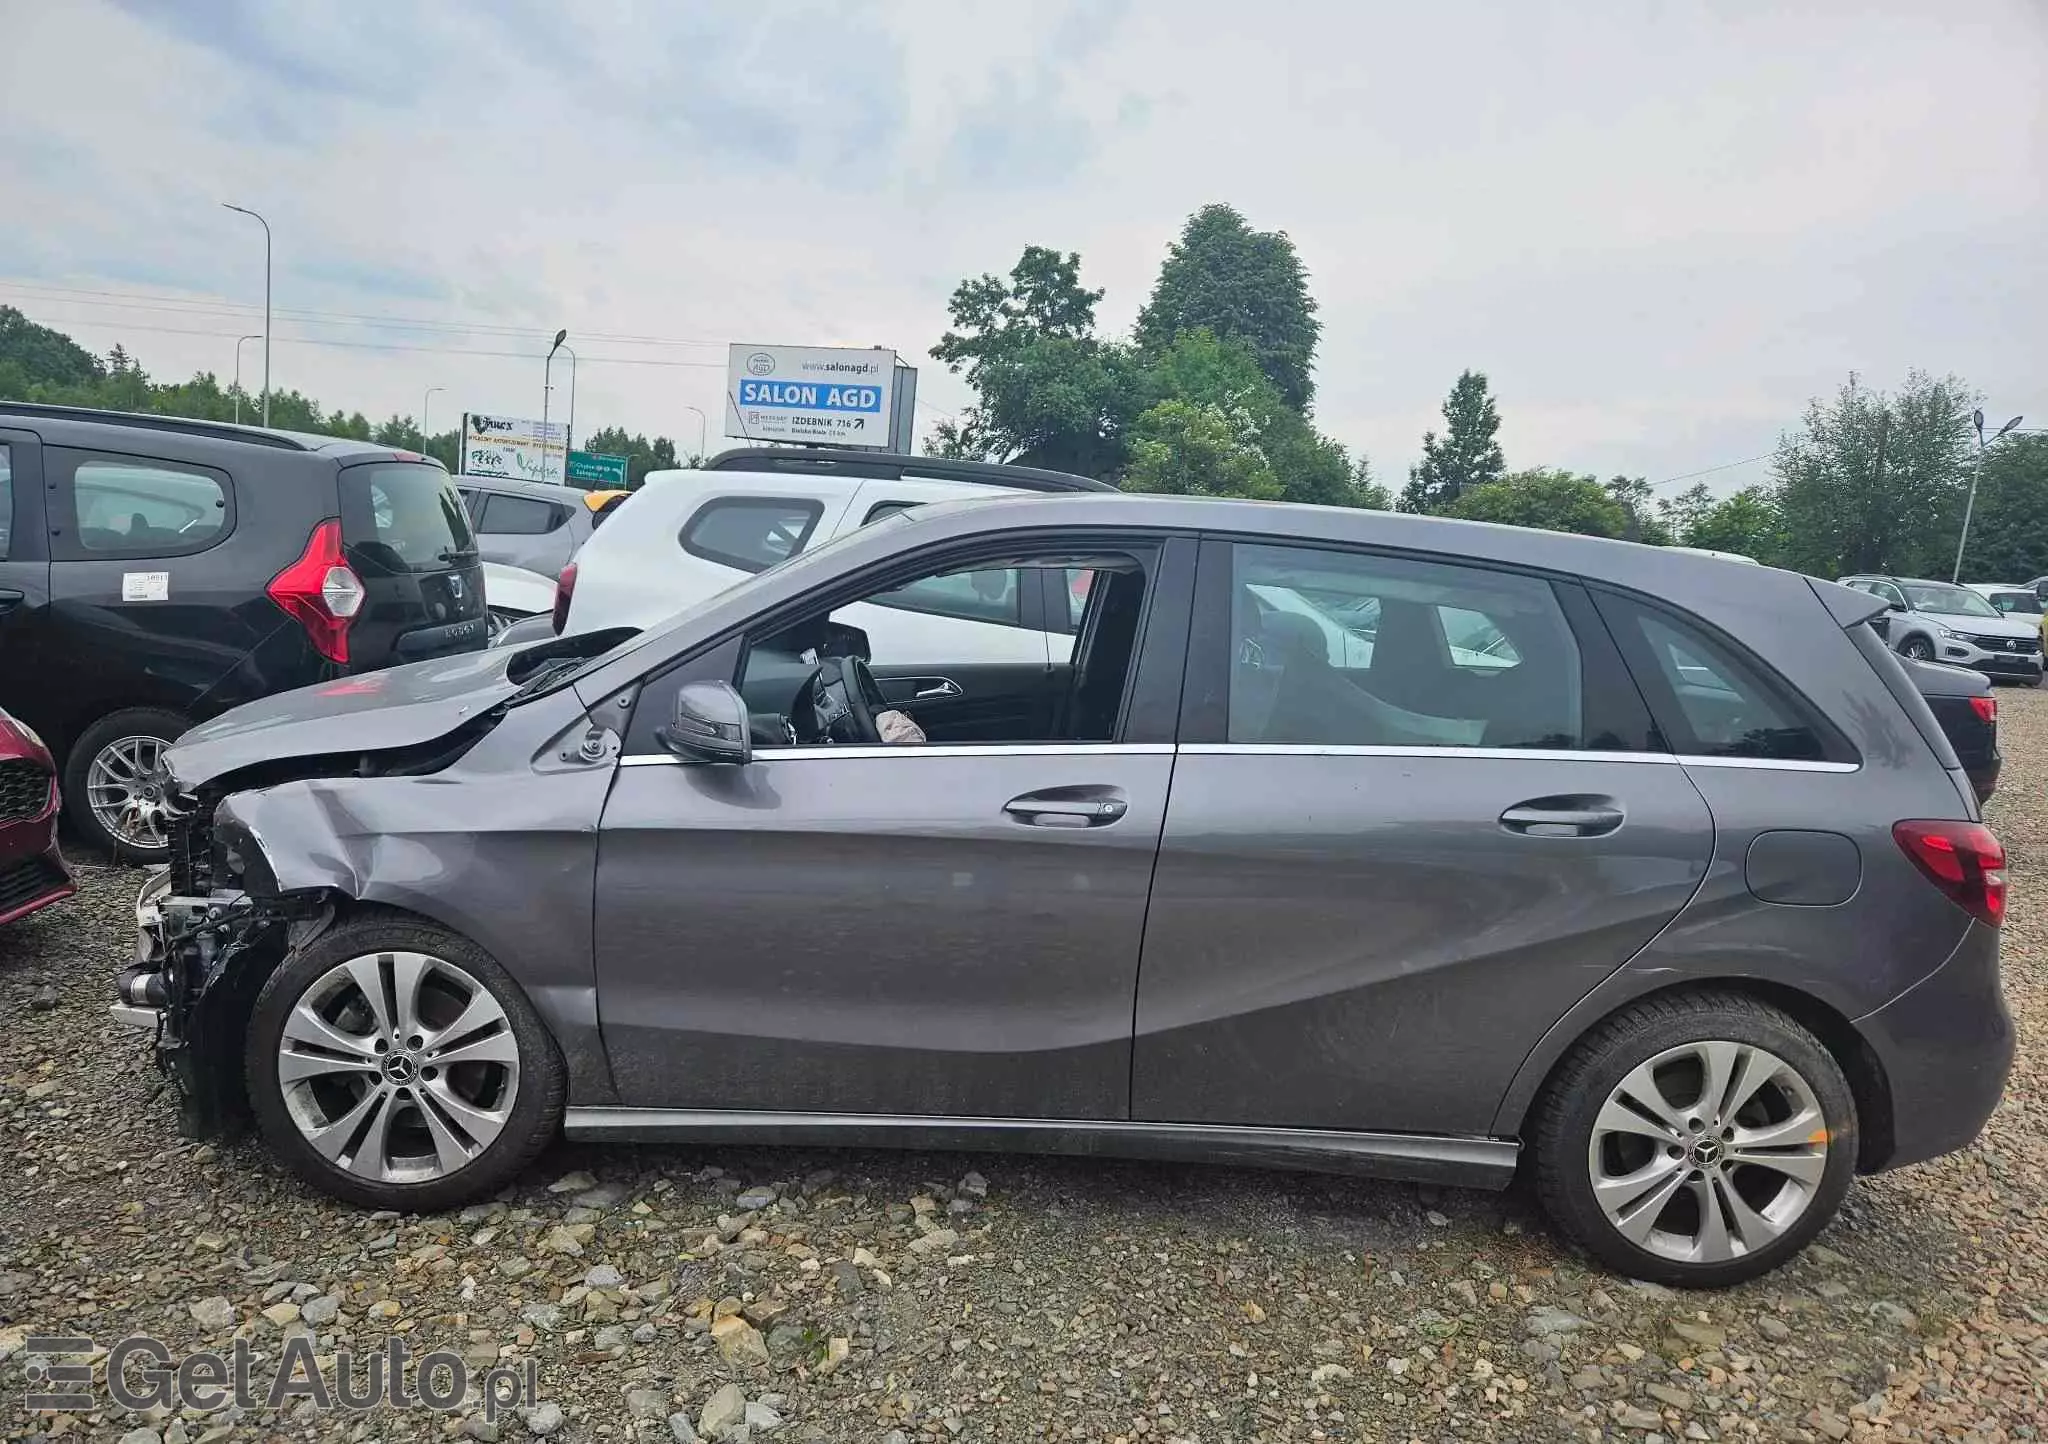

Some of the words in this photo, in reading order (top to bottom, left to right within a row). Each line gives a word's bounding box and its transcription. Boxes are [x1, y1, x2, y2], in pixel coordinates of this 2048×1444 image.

[802, 361, 879, 375] www.salonagd.pl
[744, 383, 817, 405] SALON
[826, 387, 876, 408] AGD
[792, 416, 833, 427] IZDEBNIK
[836, 419, 851, 428] 716
